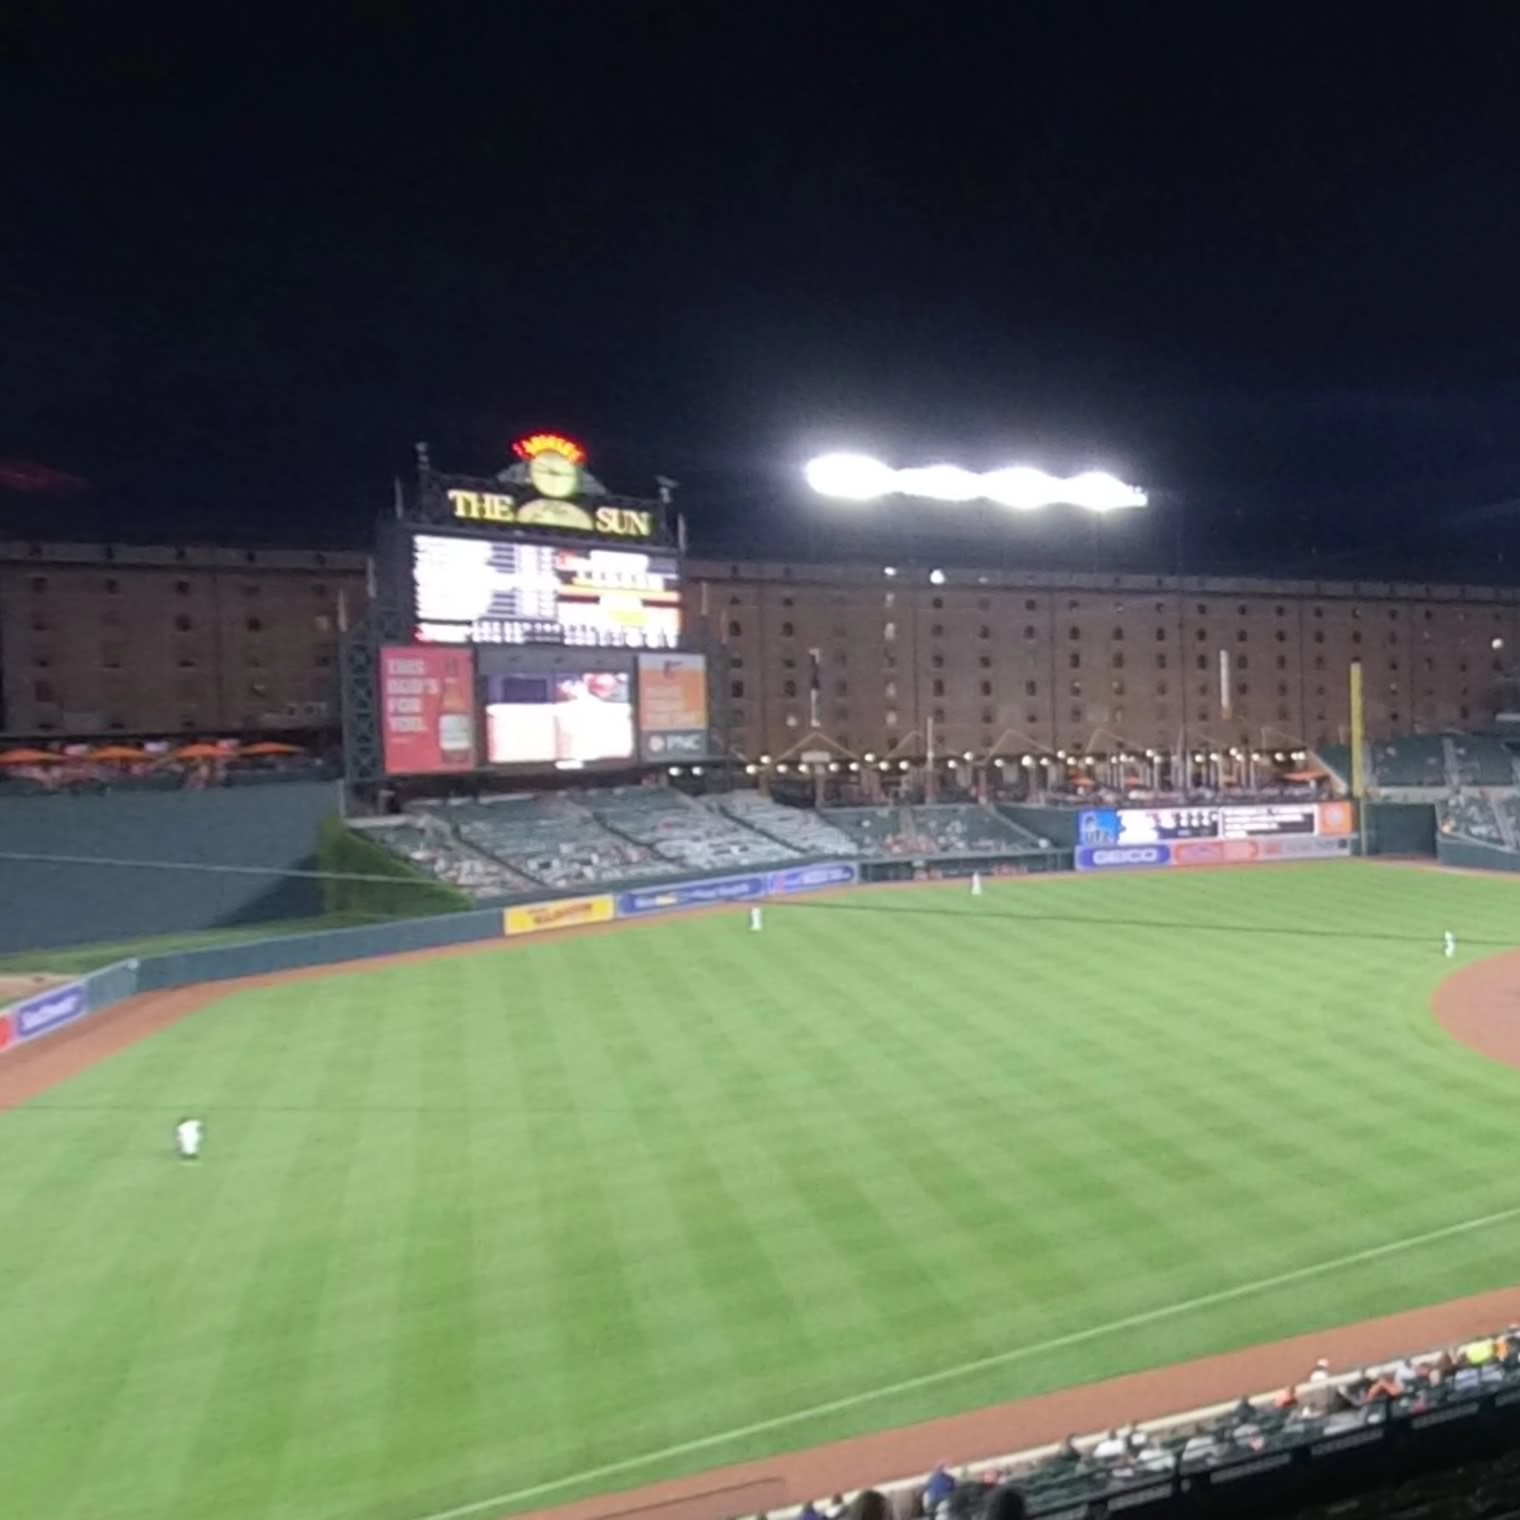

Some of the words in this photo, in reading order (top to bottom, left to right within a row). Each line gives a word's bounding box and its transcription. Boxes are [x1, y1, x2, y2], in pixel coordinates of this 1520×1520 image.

[449, 489, 514, 522] THE
[595, 507, 651, 536] SUN
[387, 659, 424, 675] THIS
[386, 678, 438, 695] BUD'S
[387, 697, 422, 713] FOR
[667, 734, 700, 751] PNC
[1092, 848, 1158, 865] GEICO
